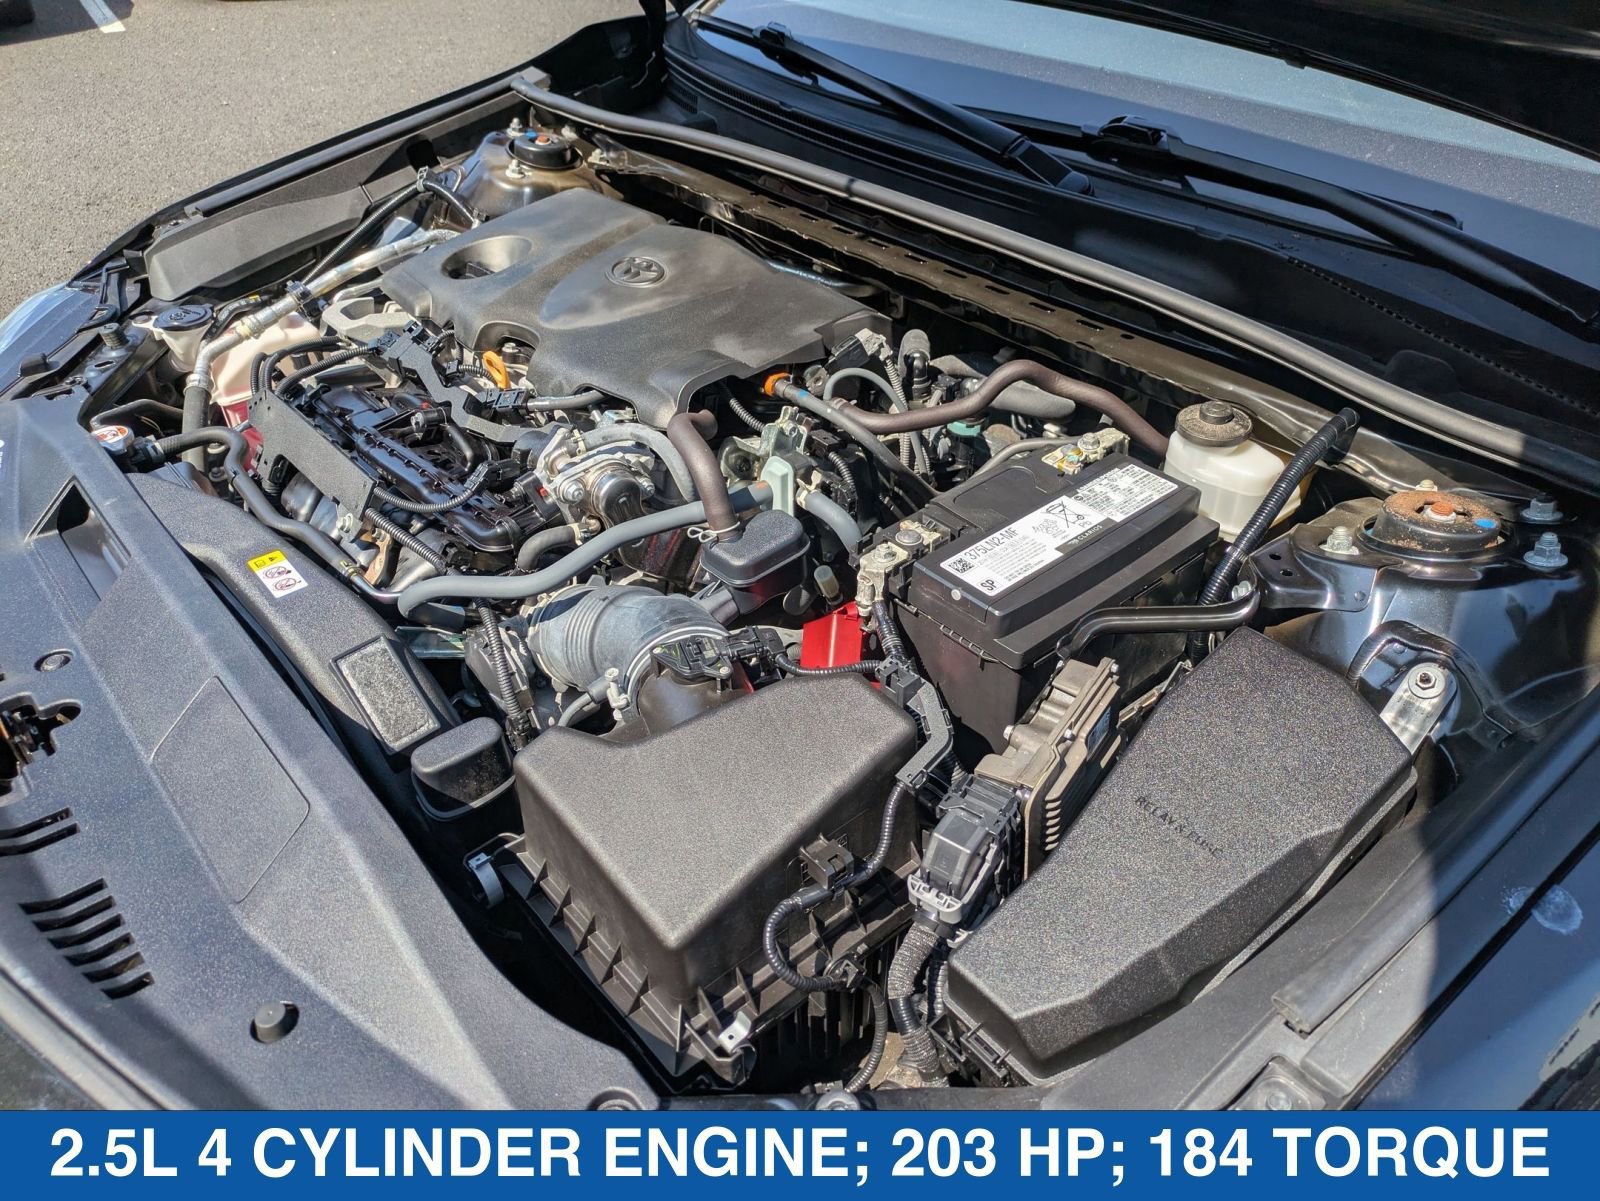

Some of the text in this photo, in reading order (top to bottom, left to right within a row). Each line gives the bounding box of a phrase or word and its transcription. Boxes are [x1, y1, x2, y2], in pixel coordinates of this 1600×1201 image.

[964, 527, 1019, 560] 375LN2-MF
[1077, 525, 1103, 541] CLARIOS
[980, 580, 997, 592] SP
[1135, 796, 1177, 825] RELAY
